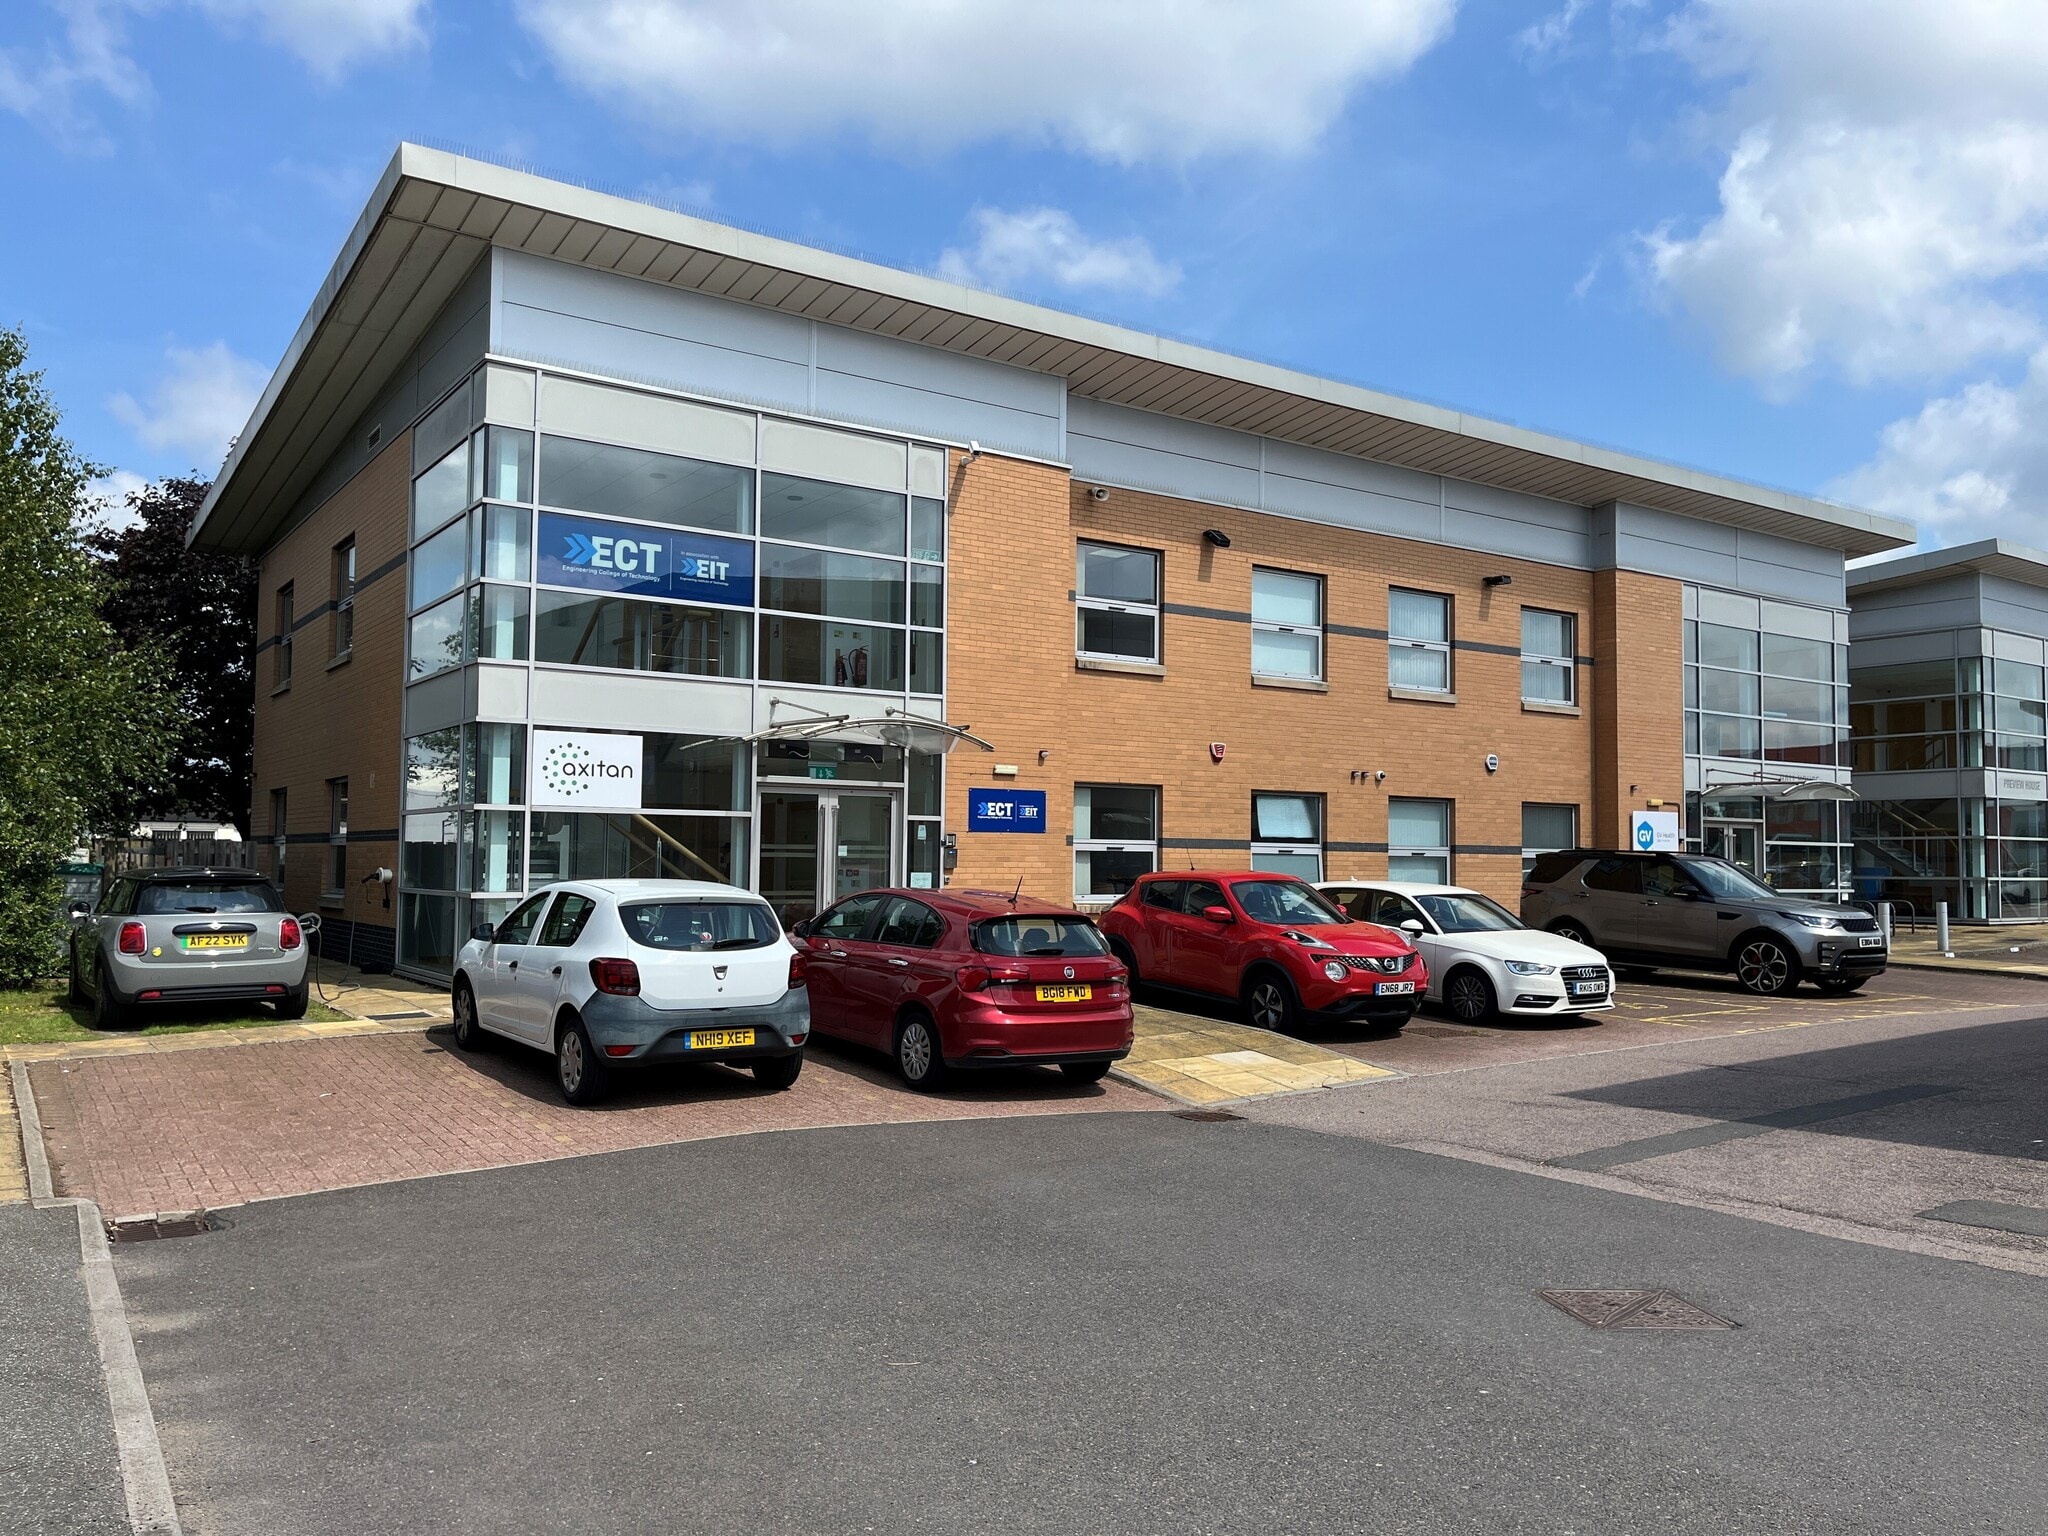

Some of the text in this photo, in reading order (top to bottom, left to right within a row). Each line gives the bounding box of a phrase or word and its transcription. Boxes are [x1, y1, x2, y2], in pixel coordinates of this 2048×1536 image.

[591, 535, 662, 574] ECT
[562, 564, 598, 575] Engineering
[598, 568, 621, 578] College
[697, 559, 730, 581] EIT
[562, 760, 633, 778] axitan
[2004, 778, 2041, 791] PREVIEW HOUSE
[987, 802, 1014, 816] ECT
[1025, 807, 1039, 816] EIT
[1639, 829, 1652, 842] GV
[190, 934, 245, 946] AF22 SVK
[1042, 986, 1086, 999] BG18 FWD
[1380, 982, 1414, 994] EN68 JRZ
[1579, 982, 1593, 993] RK15
[696, 1030, 750, 1047] NH19 XEF
